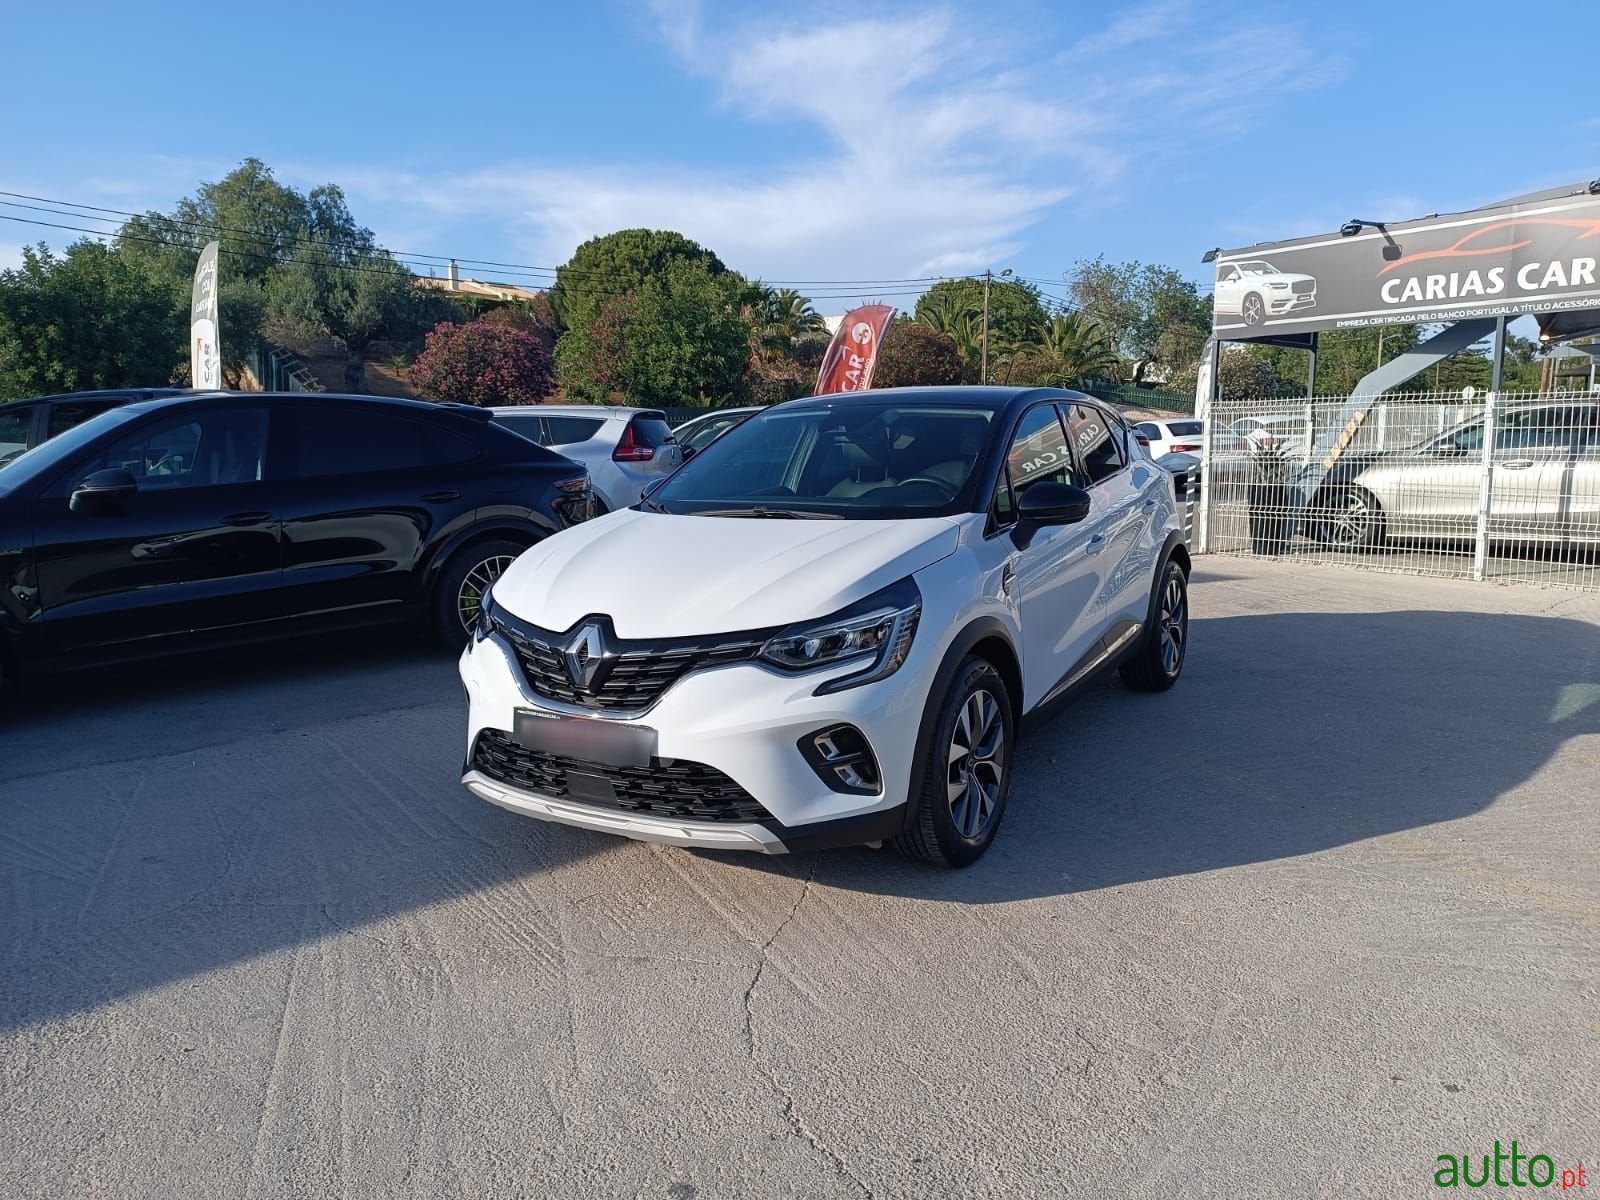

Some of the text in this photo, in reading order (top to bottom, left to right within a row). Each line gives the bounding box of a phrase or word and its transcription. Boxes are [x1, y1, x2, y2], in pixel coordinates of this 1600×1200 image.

[1381, 257, 1597, 304] CARIAS CAR
[1336, 318, 1369, 328] EMPRESA
[1369, 314, 1416, 325] CERTIFICADA
[1417, 313, 1437, 321] PELO
[1438, 310, 1465, 319] BANCO
[1466, 306, 1511, 317] PORTUGAL
[1511, 305, 1519, 313] A
[1520, 303, 1551, 312] TÍTULO
